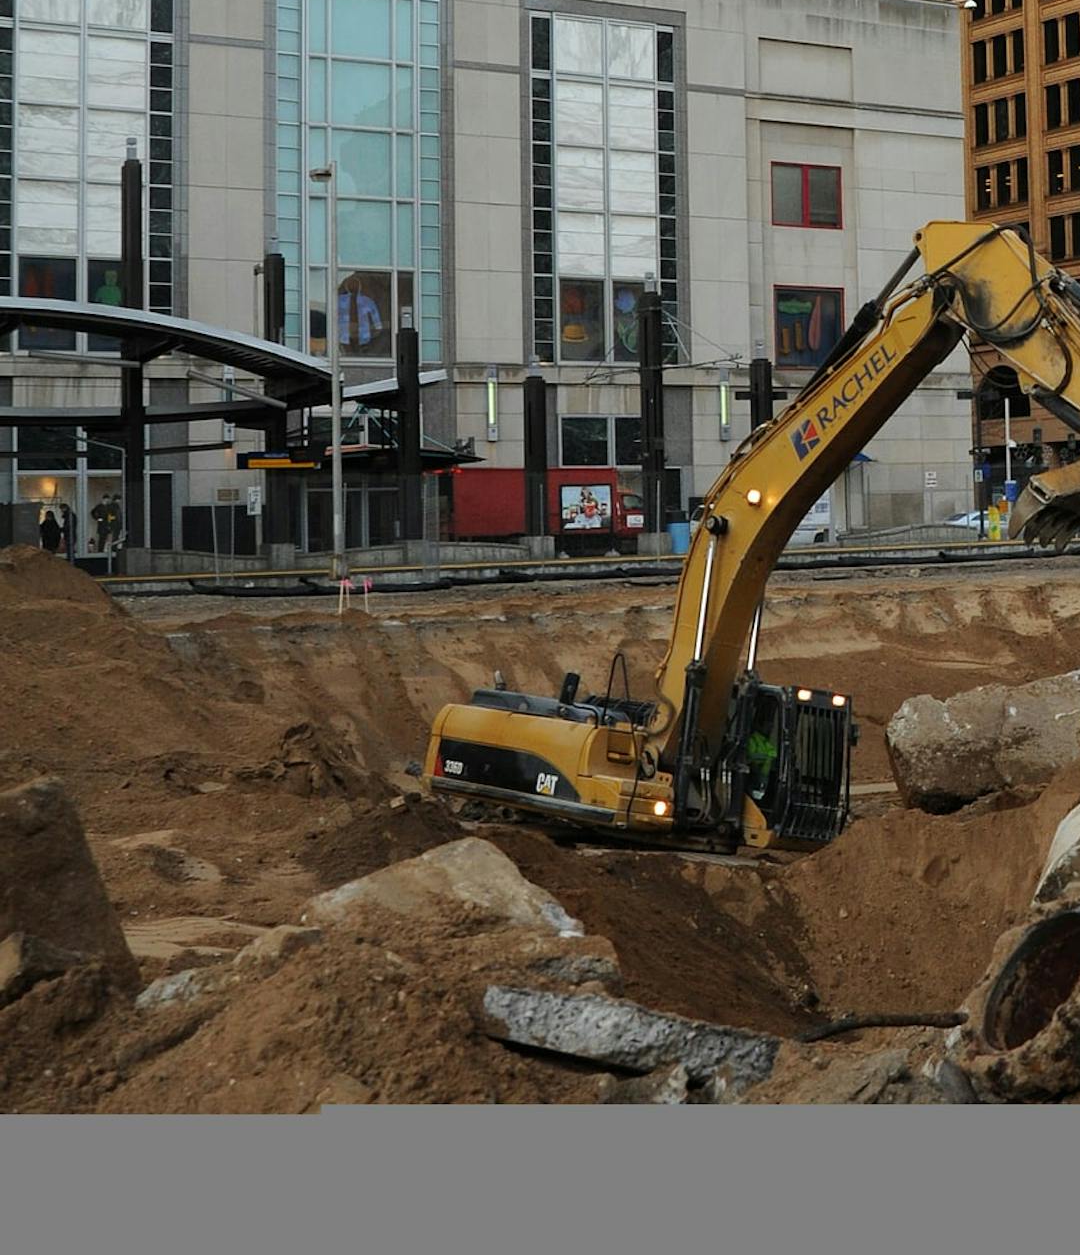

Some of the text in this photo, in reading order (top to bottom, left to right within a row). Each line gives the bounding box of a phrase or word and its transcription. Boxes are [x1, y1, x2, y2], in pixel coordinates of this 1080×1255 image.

[816, 345, 898, 431] RACHEL
[444, 759, 464, 774] 336D
[536, 772, 559, 796] CAT
